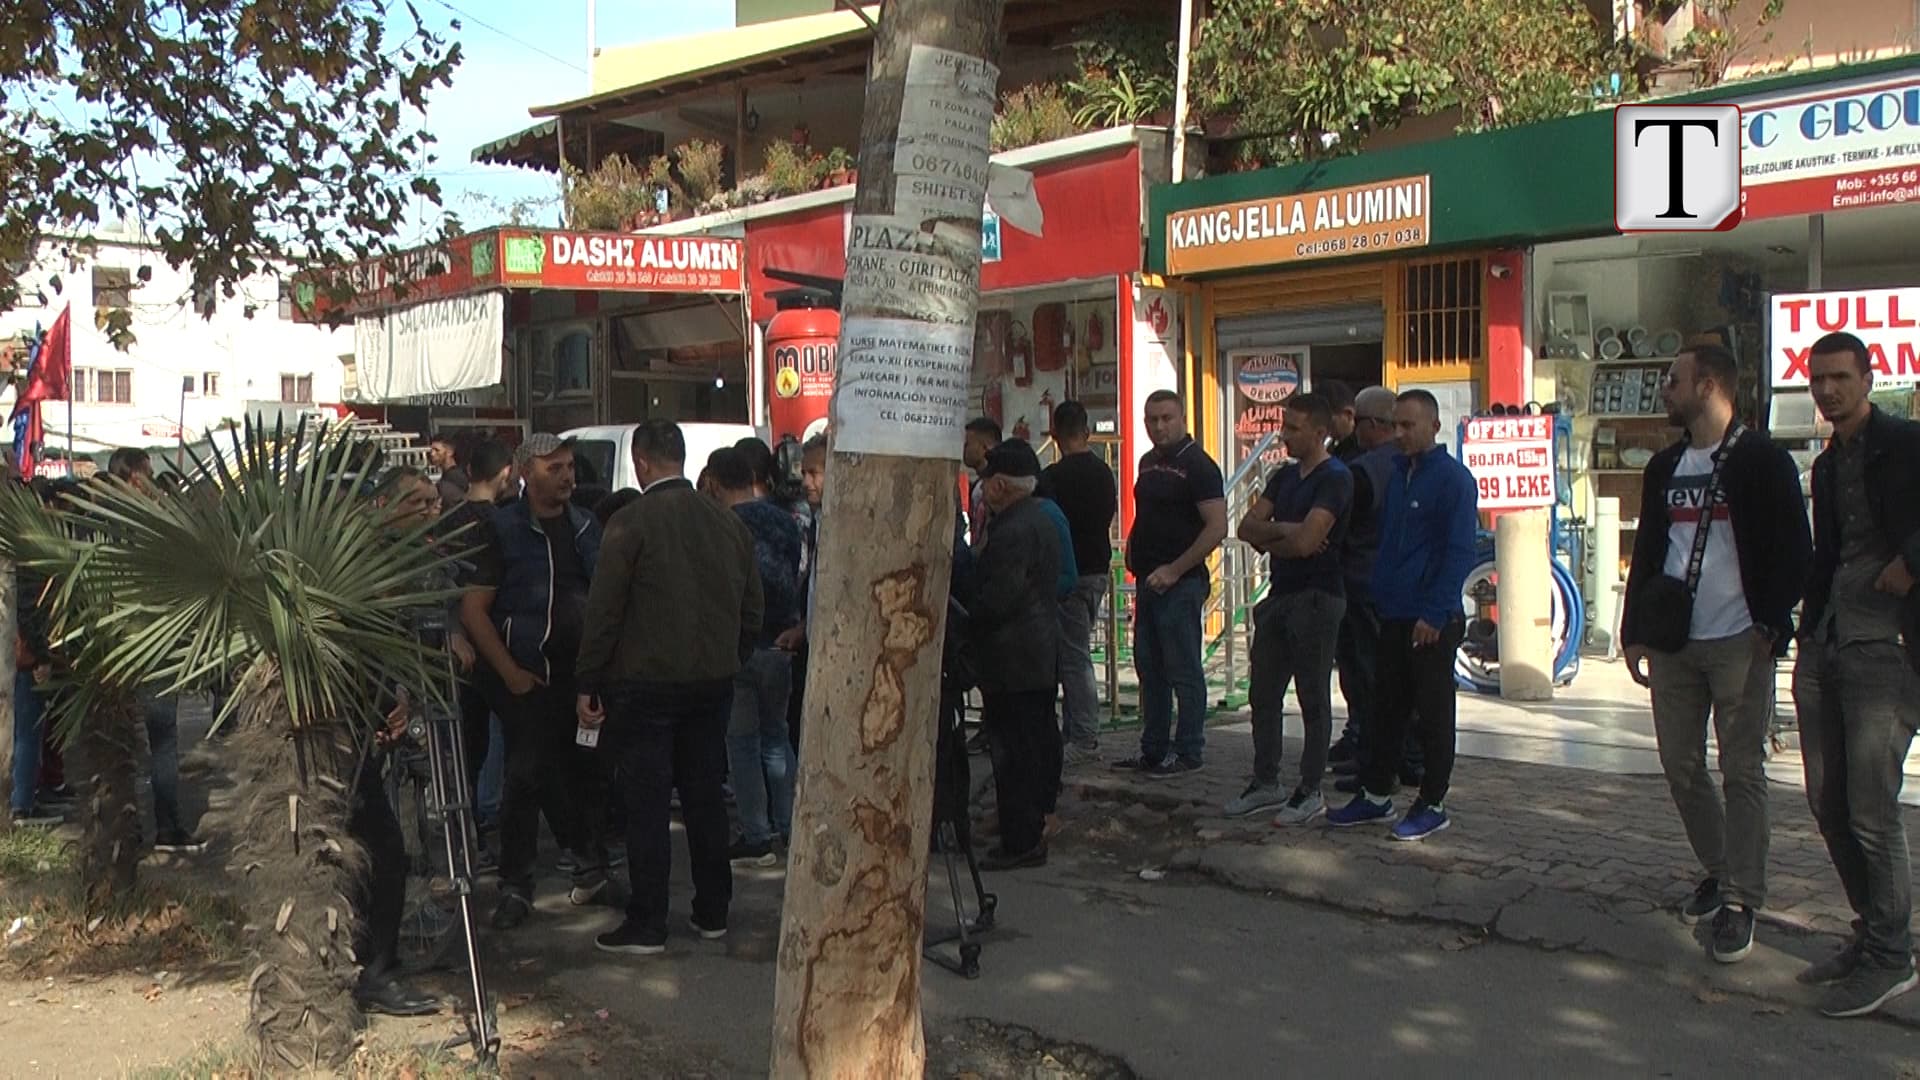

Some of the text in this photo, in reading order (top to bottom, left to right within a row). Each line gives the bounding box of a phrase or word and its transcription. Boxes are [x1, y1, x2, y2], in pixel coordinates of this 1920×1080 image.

[1795, 153, 1836, 170] AKUSTIKE
[1842, 147, 1879, 163] TERMIKE
[1836, 169, 1918, 192] Mob: +355 66
[1171, 183, 1423, 249] KANGJELLA ALUMINI
[552, 235, 636, 268] DASHI
[640, 241, 738, 270] ALUMIN
[1295, 227, 1422, 257] Cel:068 28 07 038
[399, 297, 490, 336] SALAMANDER
[1780, 295, 1920, 332] TULL
[879, 337, 947, 354] MATEMATIKE
[854, 387, 928, 404] INFORMACION
[1248, 386, 1289, 400] DEKOR
[1467, 418, 1547, 440] OFERTE
[1468, 452, 1516, 467] BOJRA
[1506, 474, 1552, 498] LEKE
